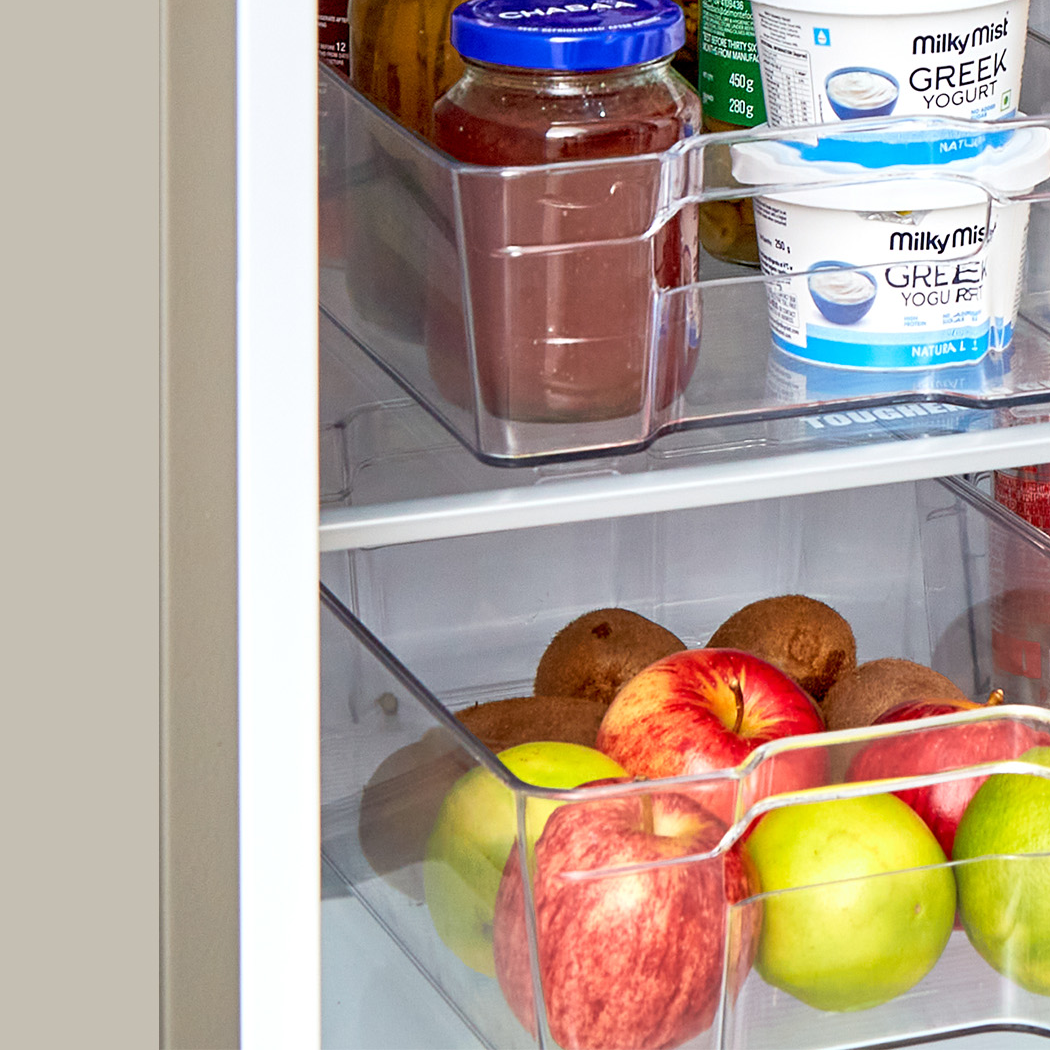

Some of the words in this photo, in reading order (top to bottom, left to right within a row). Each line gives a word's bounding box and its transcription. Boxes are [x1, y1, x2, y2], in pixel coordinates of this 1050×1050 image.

[498, 1, 637, 19] CHABAA
[336, 42, 346, 52] 12
[728, 39, 747, 52] THIRTY
[908, 48, 1008, 92] GREEK
[922, 80, 998, 110] YOGURT
